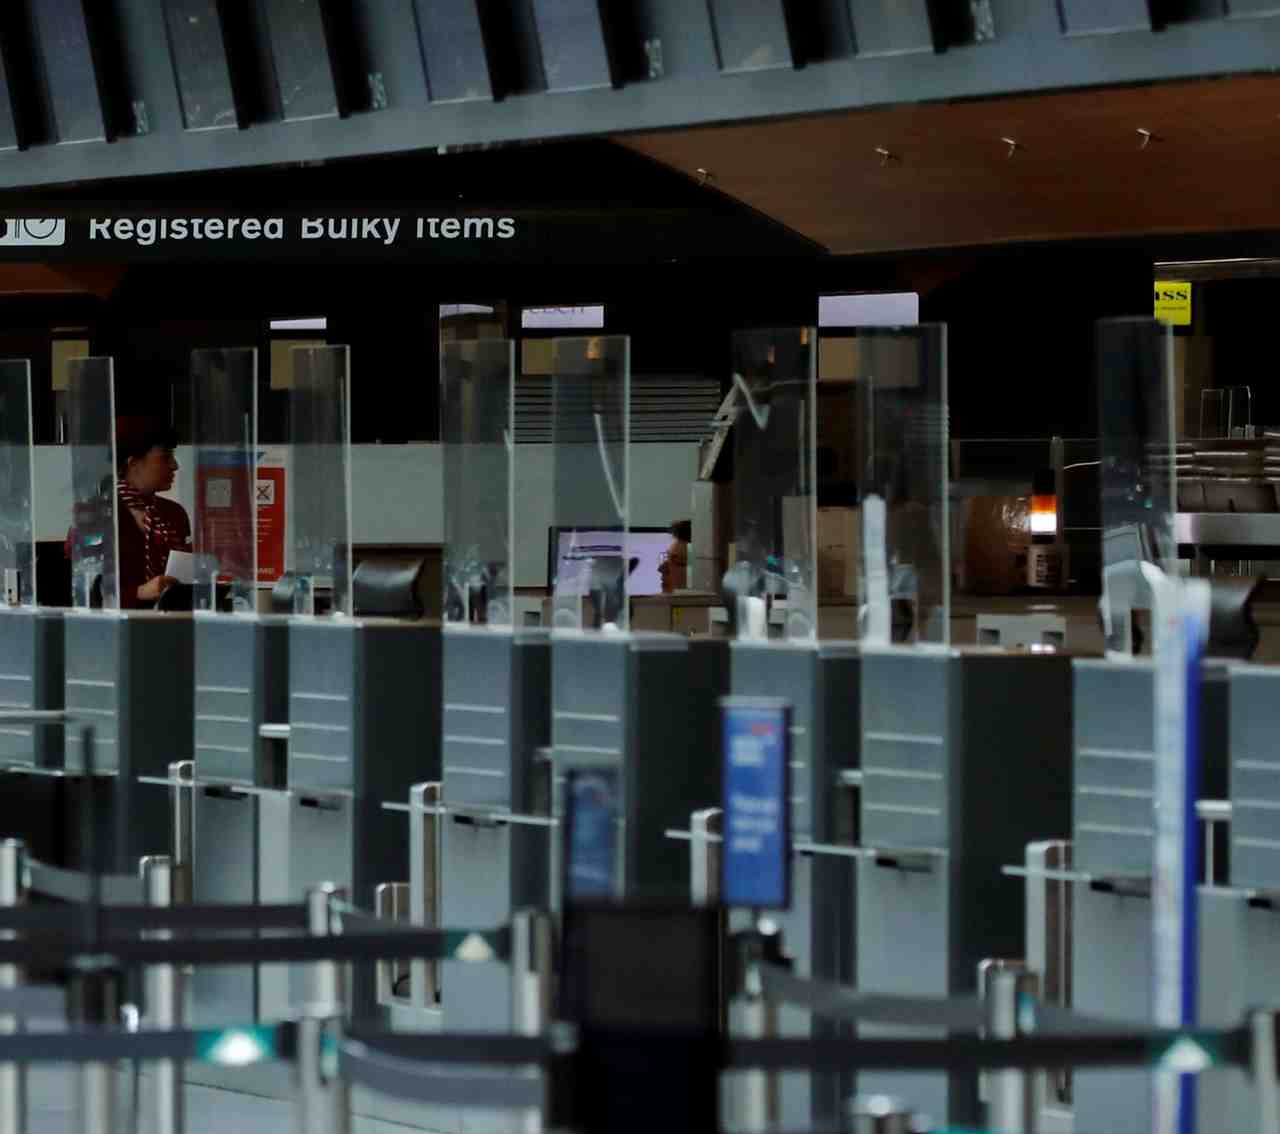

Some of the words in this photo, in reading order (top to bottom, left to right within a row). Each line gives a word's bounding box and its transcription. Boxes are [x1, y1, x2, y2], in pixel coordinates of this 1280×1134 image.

[89, 218, 283, 246] Registered
[301, 218, 401, 245] Bulky
[416, 218, 516, 239] Items
[1155, 291, 1188, 301] ss
